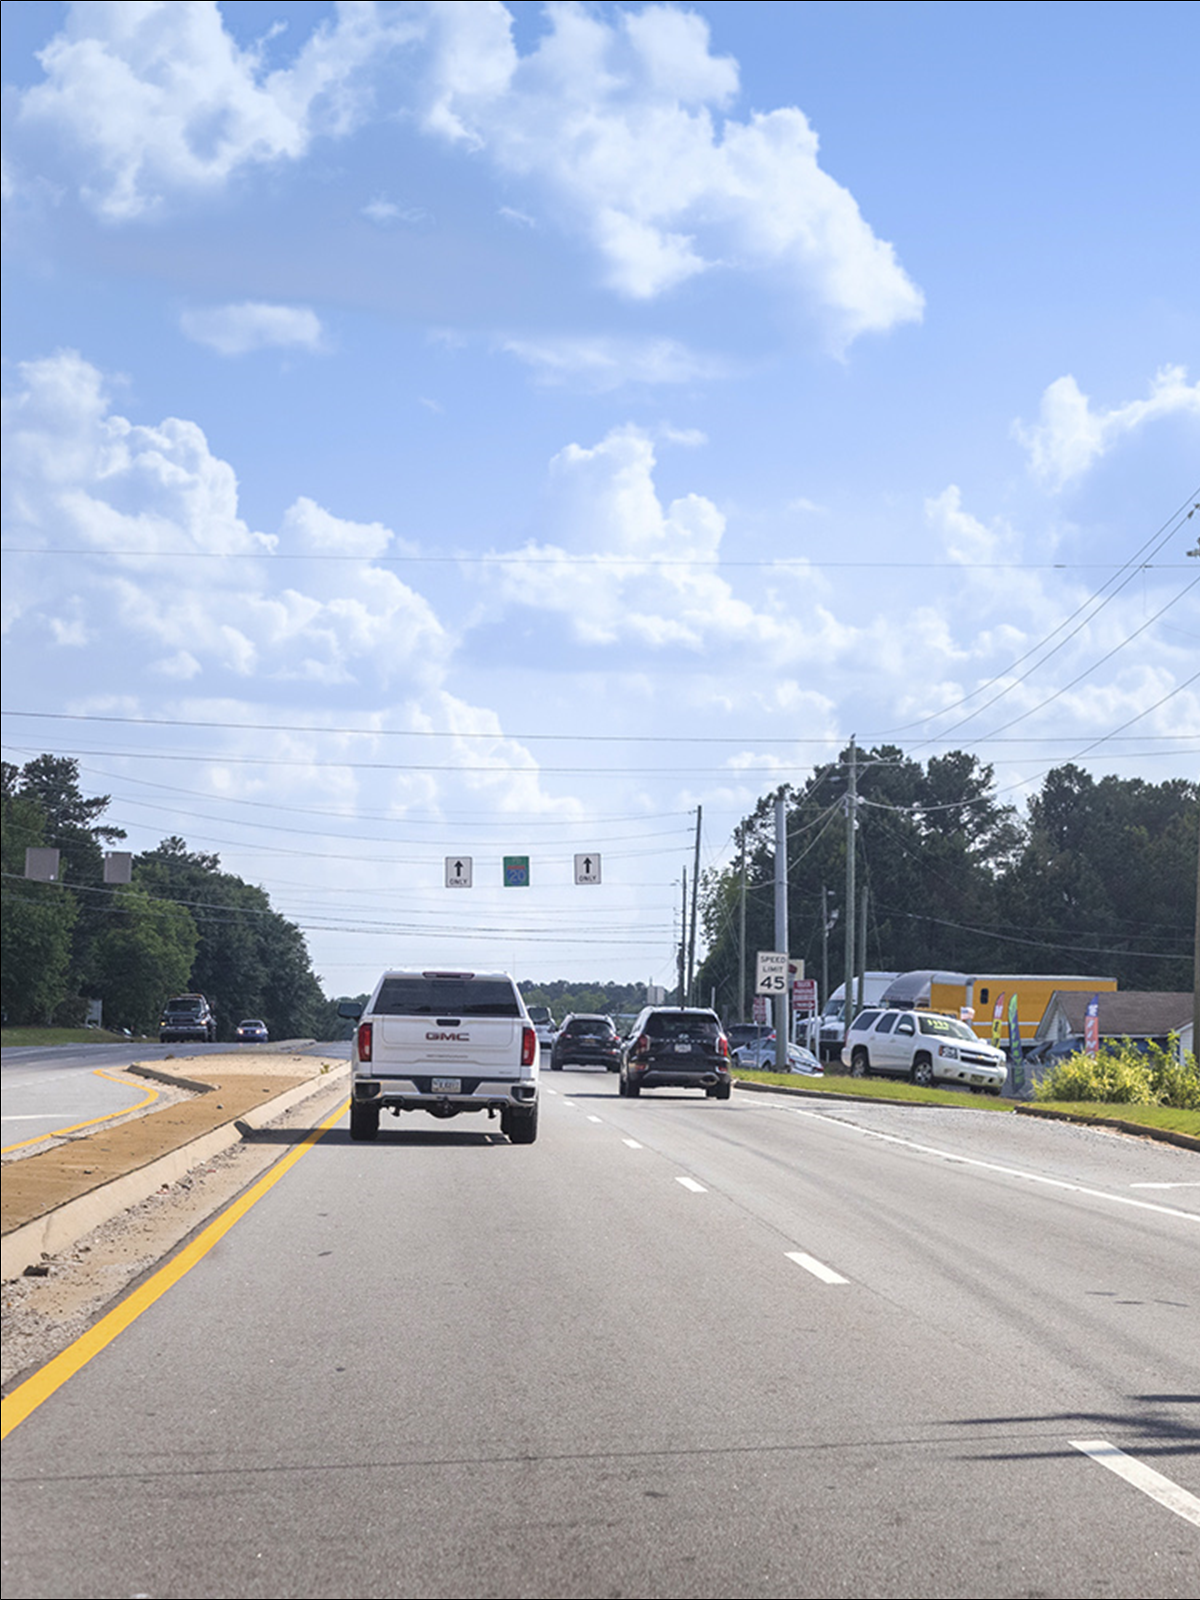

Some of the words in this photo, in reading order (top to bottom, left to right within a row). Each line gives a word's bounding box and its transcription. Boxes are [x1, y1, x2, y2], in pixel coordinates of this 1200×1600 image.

[510, 869, 527, 882] 20
[760, 956, 786, 964] SPEED
[760, 976, 785, 990] 45
[425, 1032, 470, 1042] GMC
